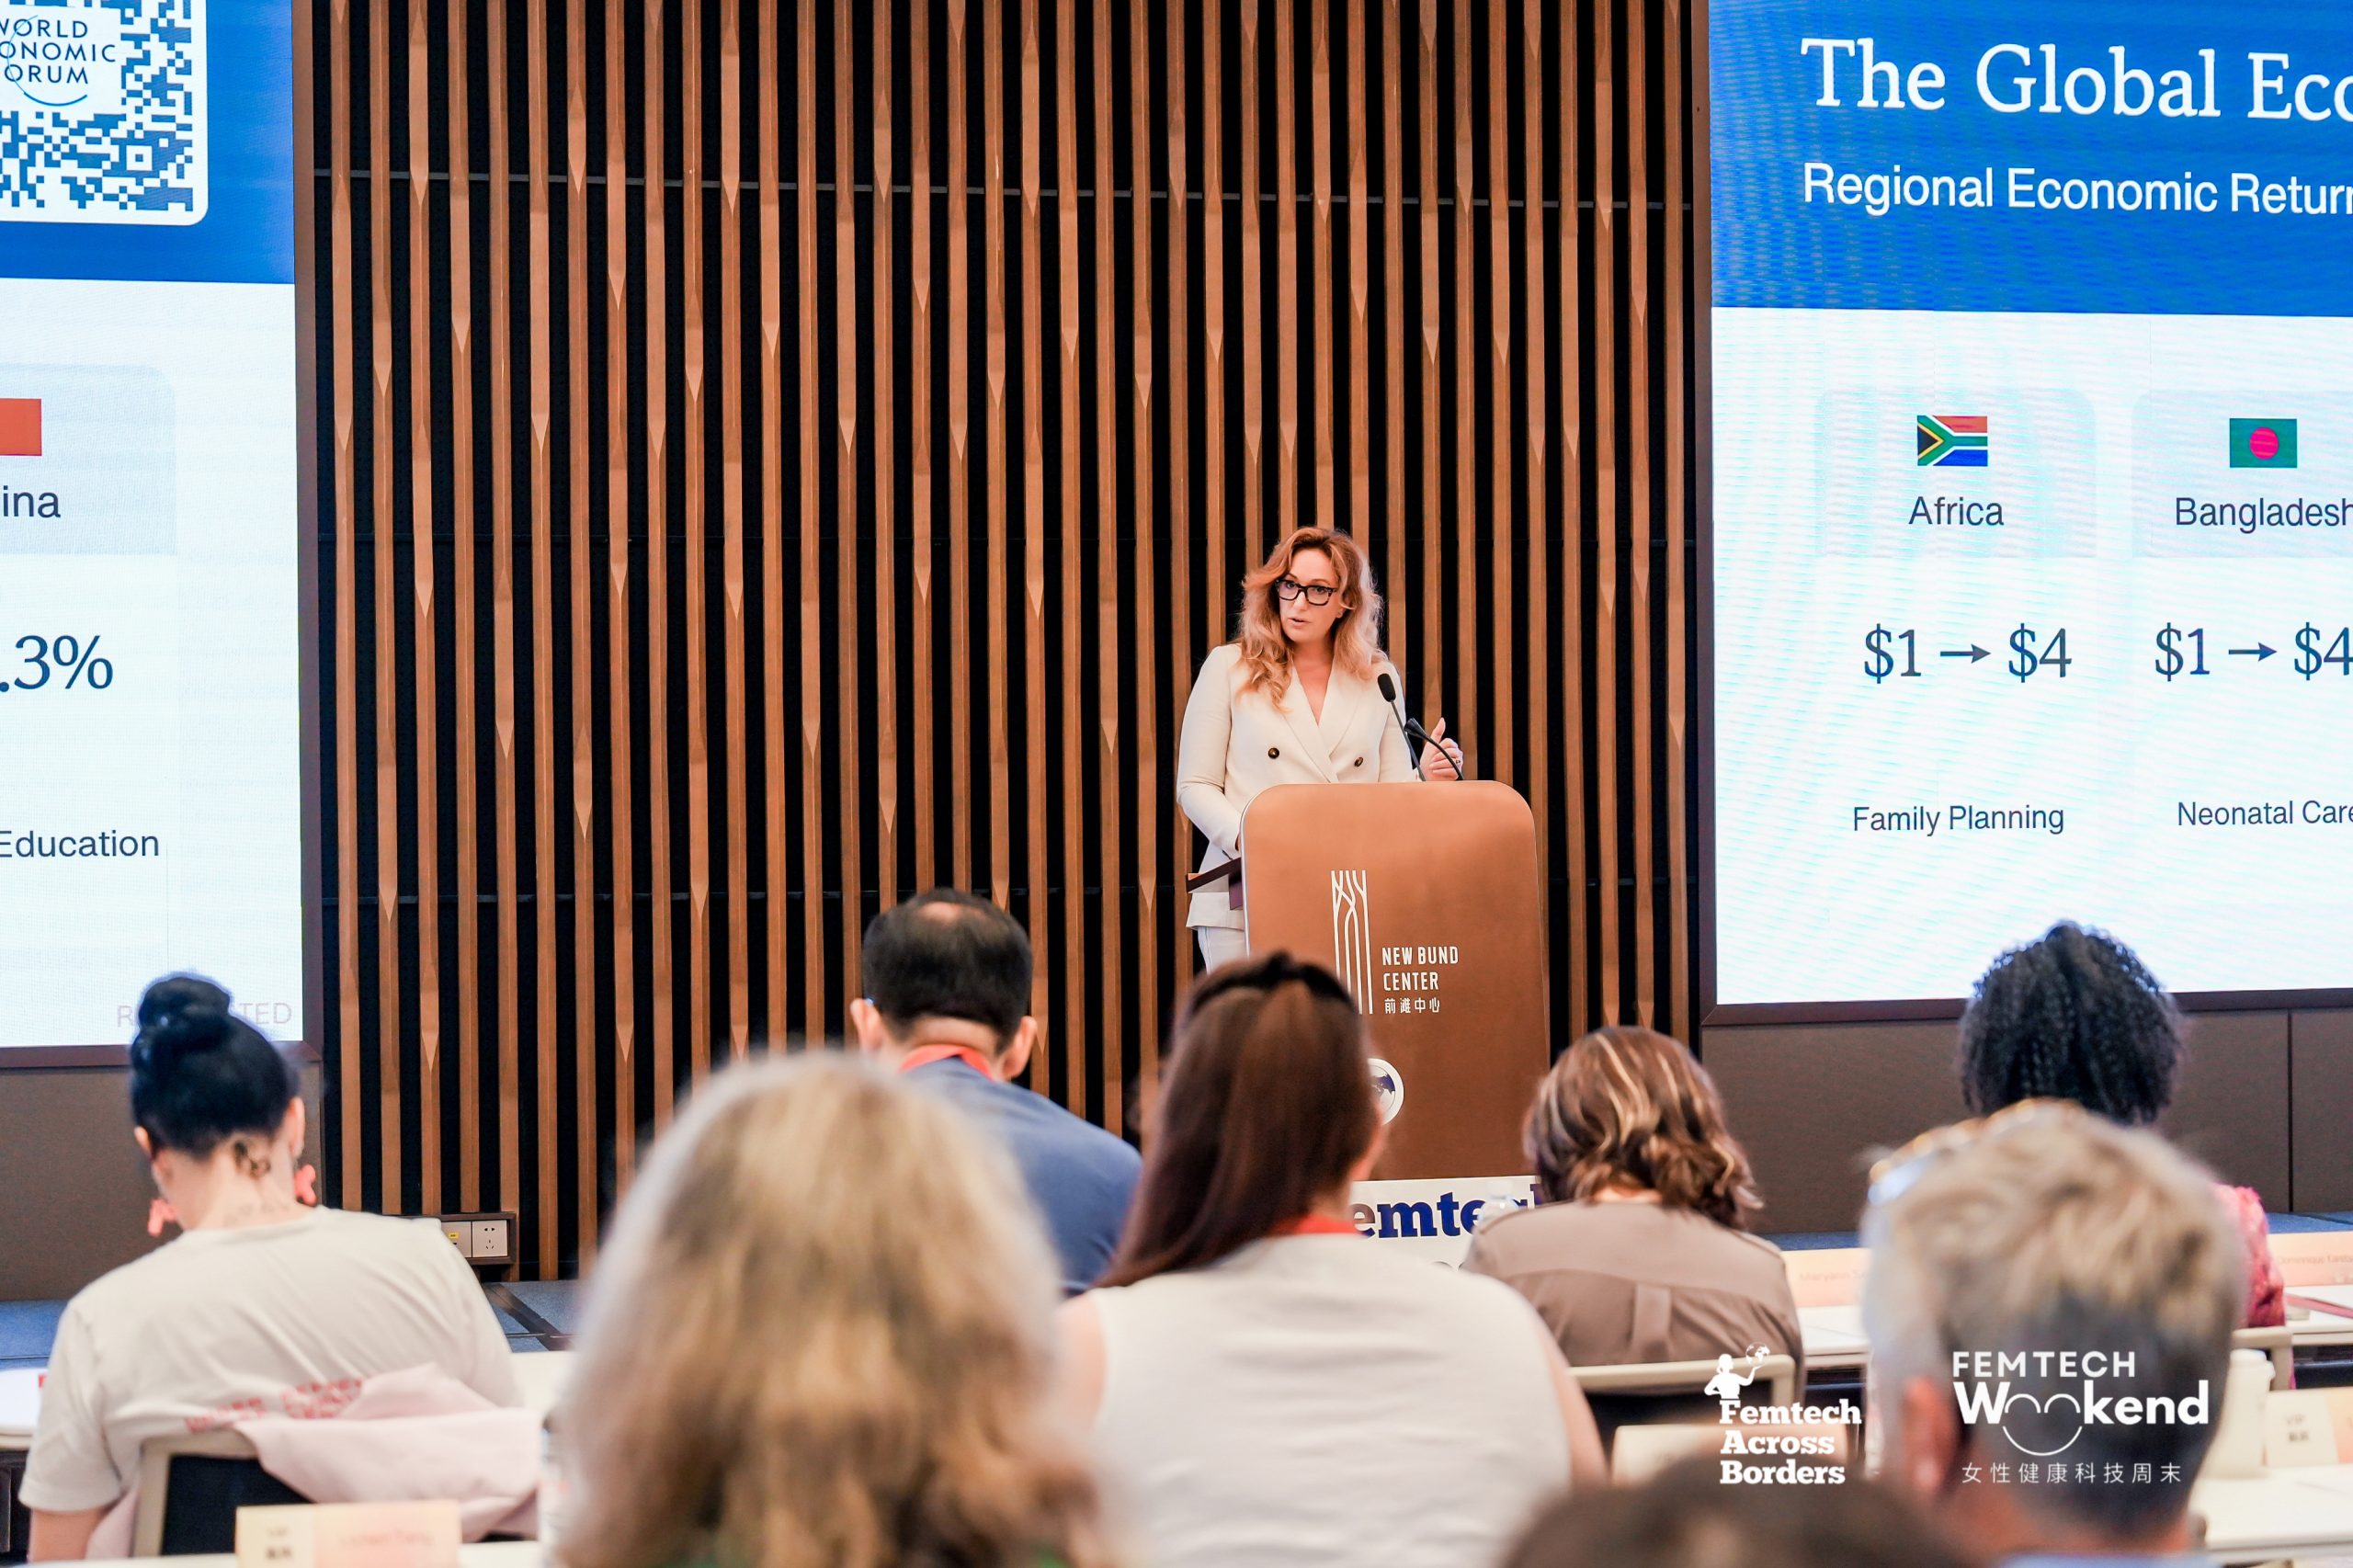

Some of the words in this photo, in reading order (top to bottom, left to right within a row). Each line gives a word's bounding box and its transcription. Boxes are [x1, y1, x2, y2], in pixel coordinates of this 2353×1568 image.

[0, 40, 116, 62] ONOMIC
[5, 63, 88, 85] ORUM
[1801, 37, 1946, 110] The
[1976, 43, 2222, 117] Global
[1804, 162, 1993, 216] Regional
[2007, 167, 2218, 212] Economic
[3, 484, 62, 518] ina
[1908, 495, 2005, 527] Africa
[2176, 497, 2353, 534] Bangladesh
[1864, 623, 1922, 684] $1
[2008, 622, 2073, 684] $4
[2154, 622, 2211, 682] $1
[2293, 621, 2353, 681] $4
[1854, 805, 1940, 836] Family
[1949, 804, 2063, 835] Planning
[2178, 801, 2293, 826] Neonatal
[1381, 947, 1413, 966] NEW
[1417, 946, 1459, 965] BUND
[1383, 971, 1439, 992] CENTER
